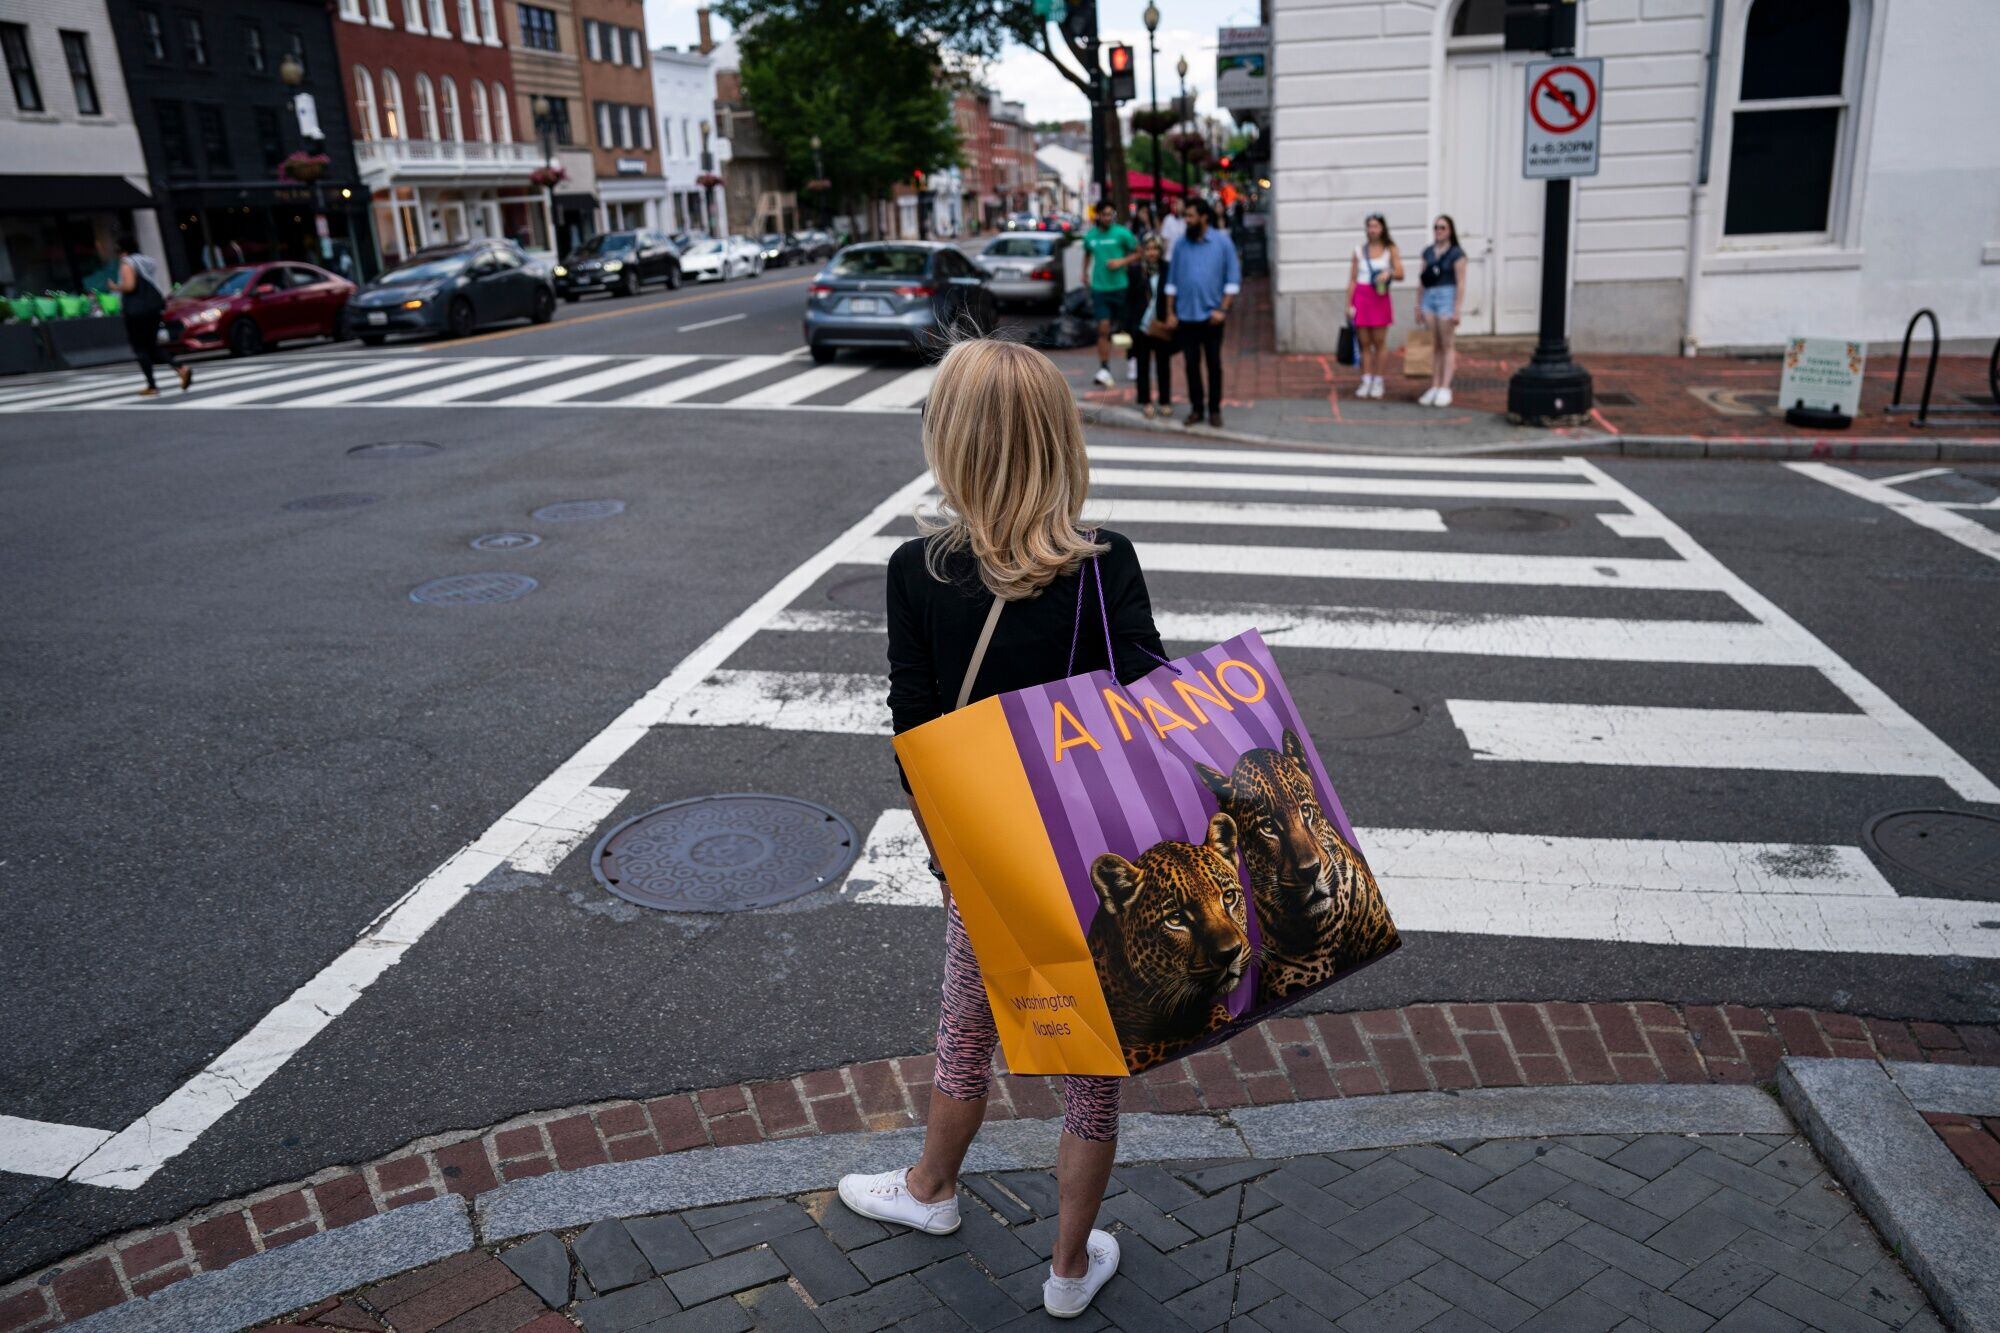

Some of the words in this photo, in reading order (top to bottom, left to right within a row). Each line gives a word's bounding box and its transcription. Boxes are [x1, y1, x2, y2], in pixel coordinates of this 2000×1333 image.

[1054, 701, 1102, 762] A
[1009, 993, 1078, 1012] Washington
[1032, 1020, 1071, 1038] Naples
